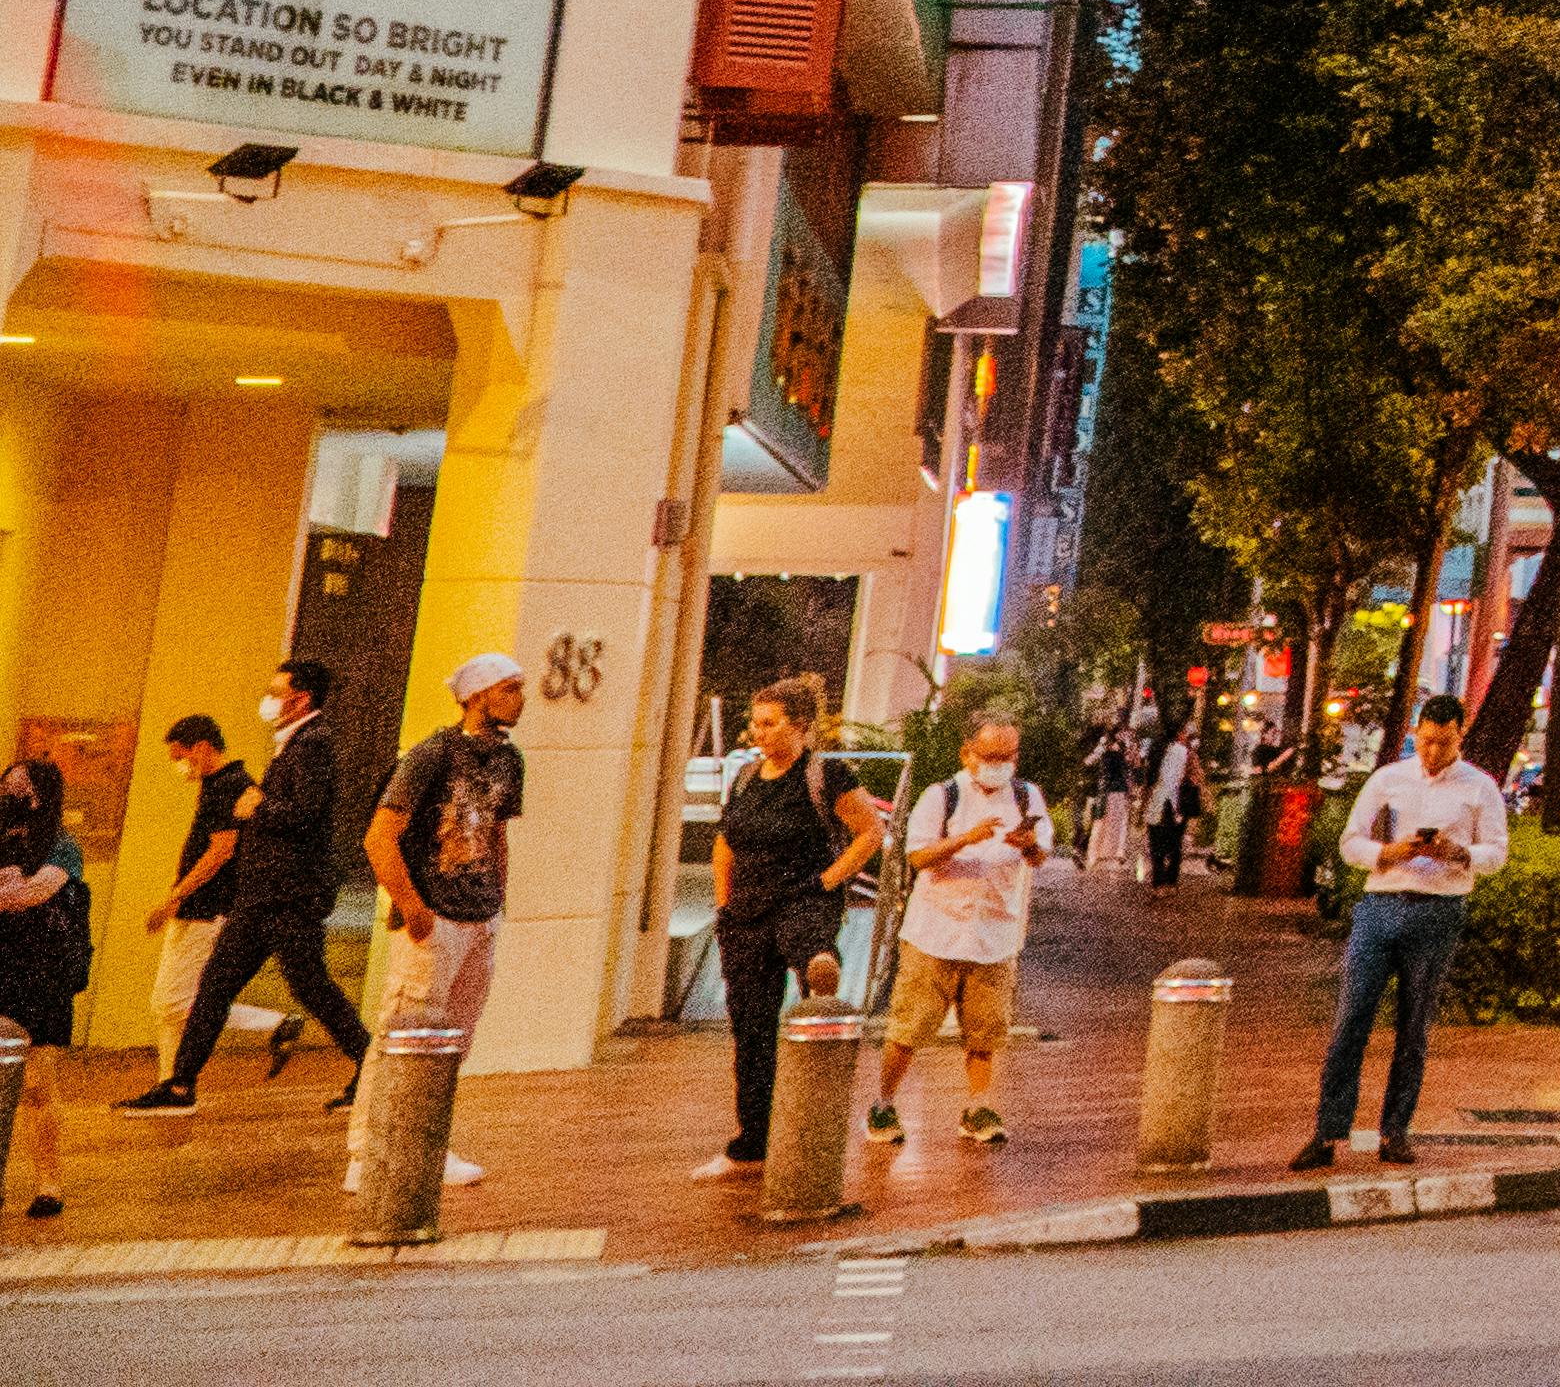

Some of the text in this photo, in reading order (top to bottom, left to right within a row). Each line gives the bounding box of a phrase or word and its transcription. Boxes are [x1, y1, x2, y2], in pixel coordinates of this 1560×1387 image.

[139, 22, 502, 93] YOU STAND OUT DAY & NIGHT
[331, 13, 378, 44] SO
[387, 20, 508, 62] BRIGHT
[170, 61, 468, 121] EVEN IN BLACK & WHITE
[541, 633, 602, 703] 88
